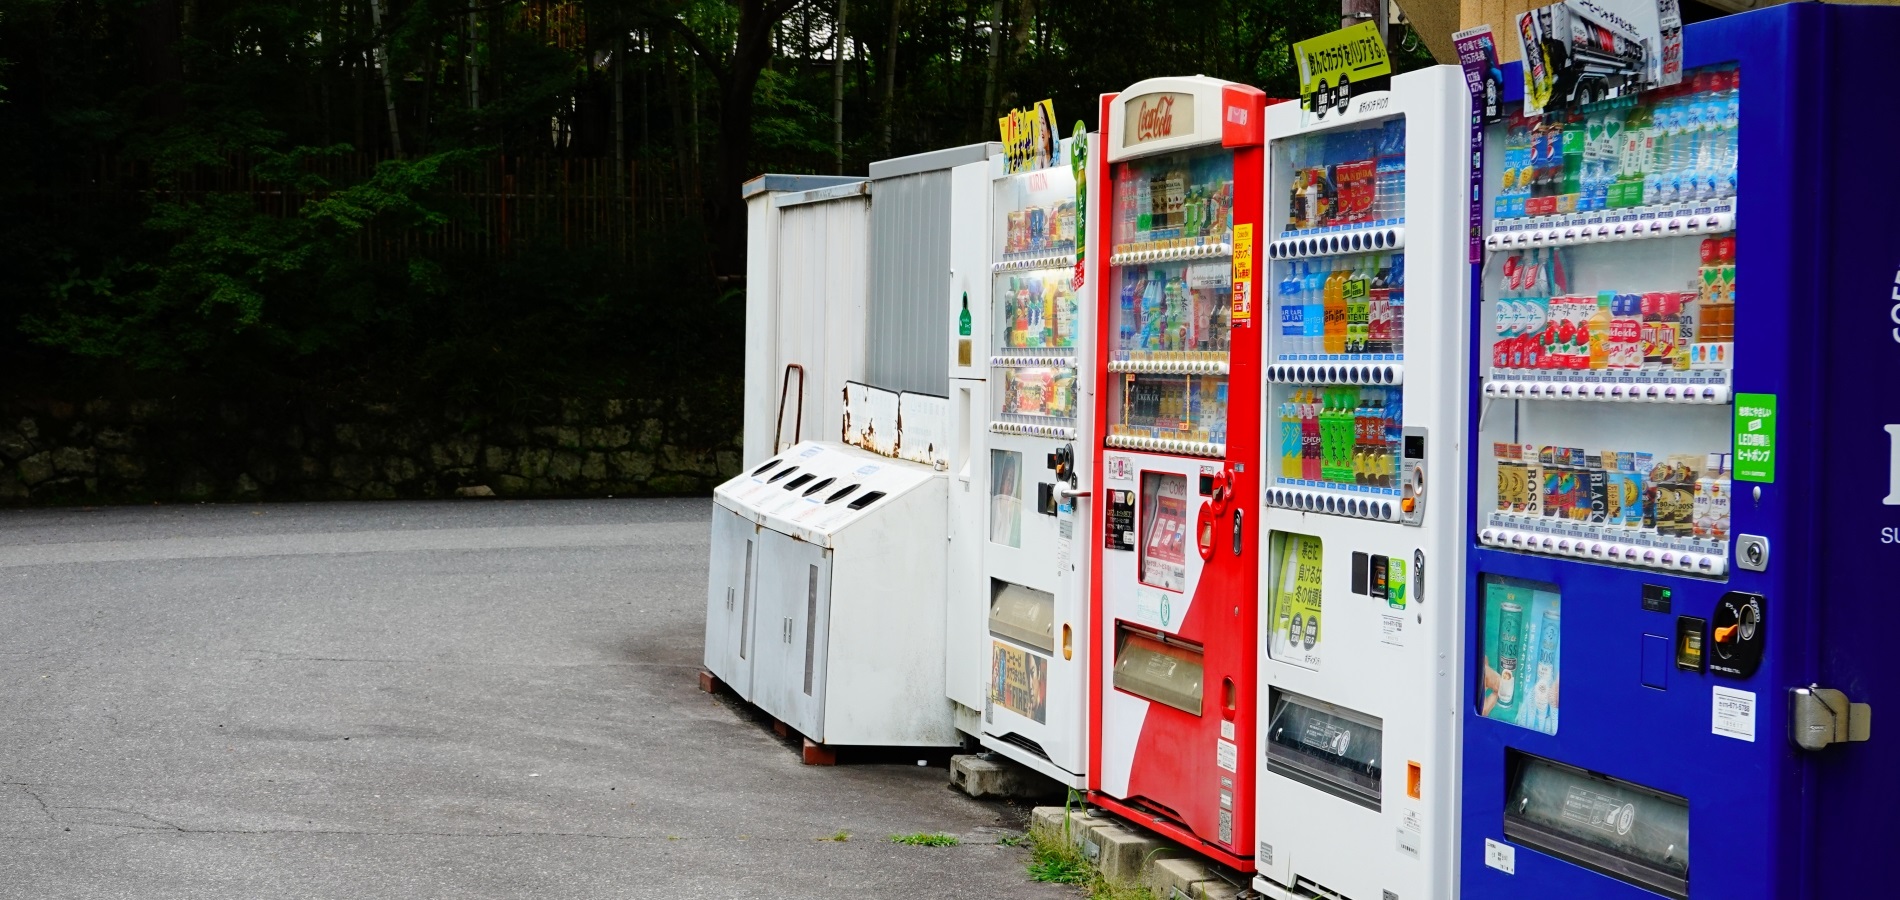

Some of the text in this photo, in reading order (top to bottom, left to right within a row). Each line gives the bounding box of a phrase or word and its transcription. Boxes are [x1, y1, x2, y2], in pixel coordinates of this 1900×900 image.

[1737, 449, 1771, 463] ヒートポンプ
[1527, 468, 1538, 512] BOSS
[1591, 471, 1605, 523] BLACK
